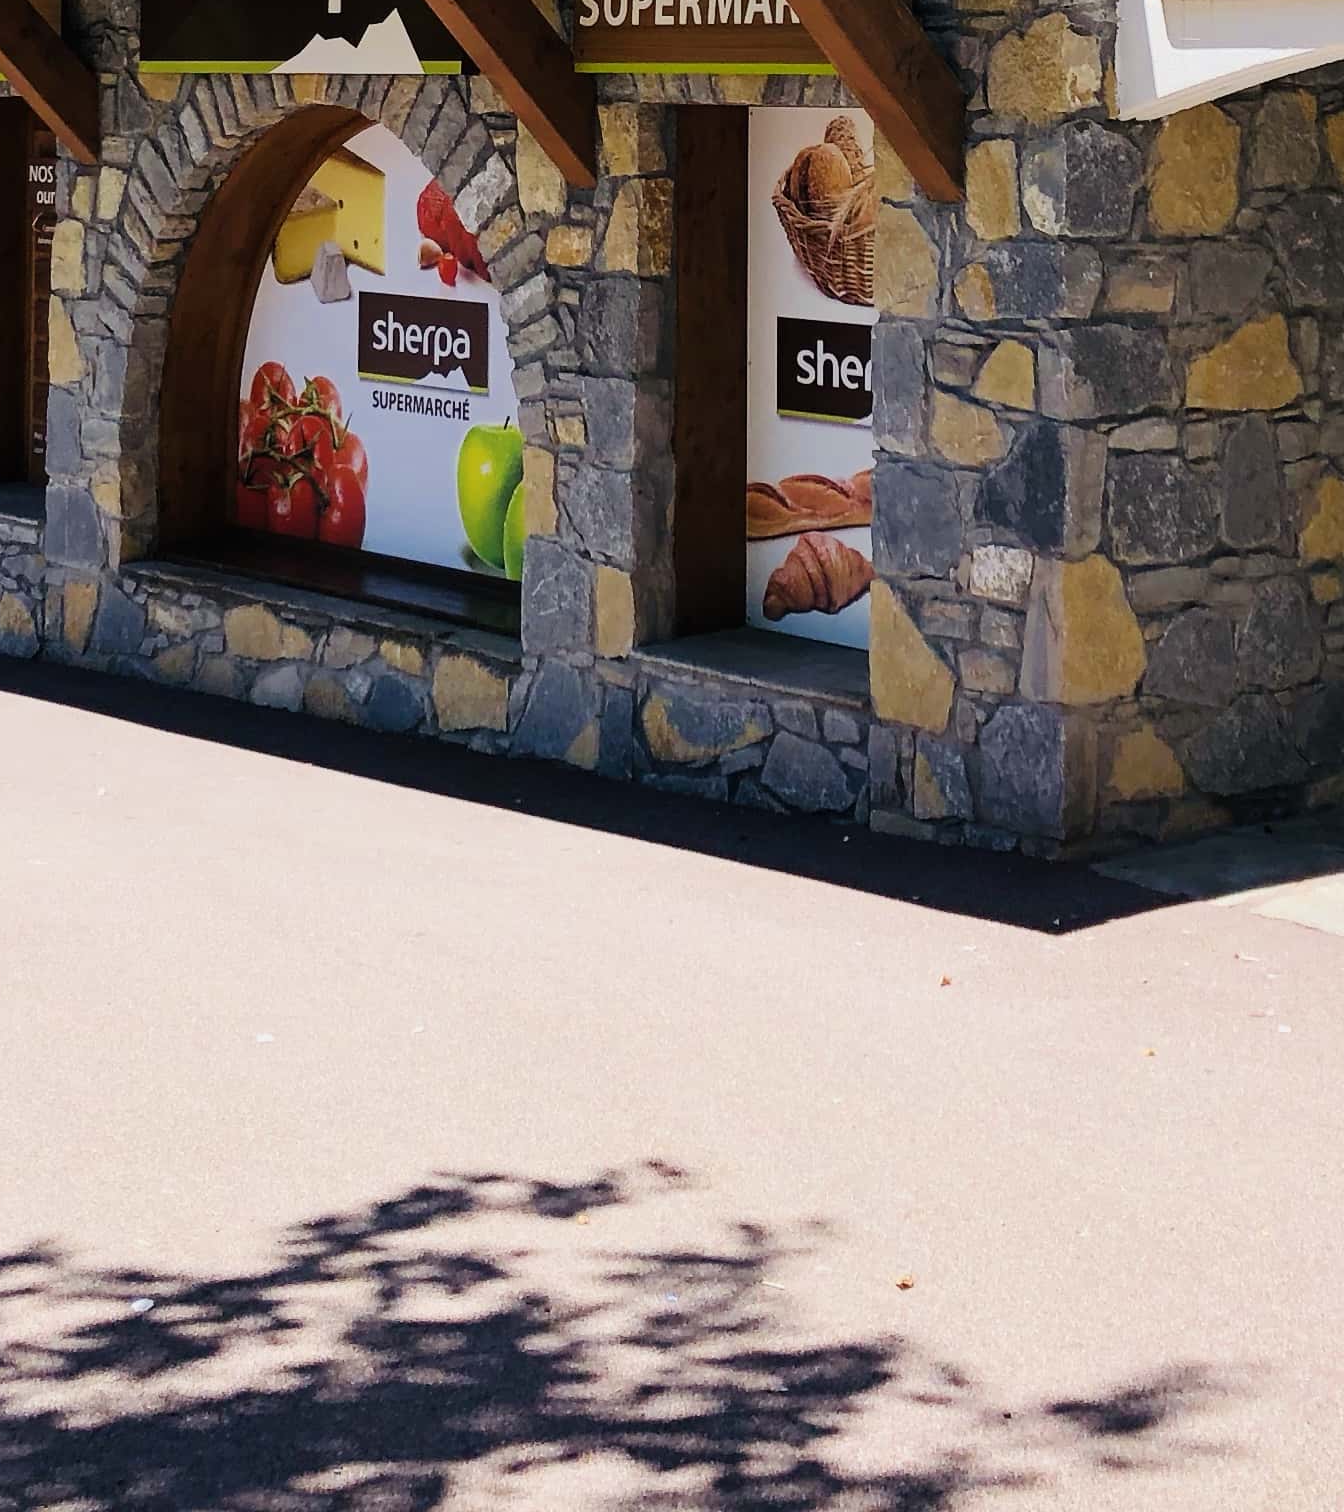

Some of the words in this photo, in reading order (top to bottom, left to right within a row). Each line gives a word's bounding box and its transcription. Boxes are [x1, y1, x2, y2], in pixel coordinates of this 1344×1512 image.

[28, 165, 54, 183] NOS
[372, 310, 471, 366] sherpa
[372, 389, 471, 421] SUPERMARCHÉ
